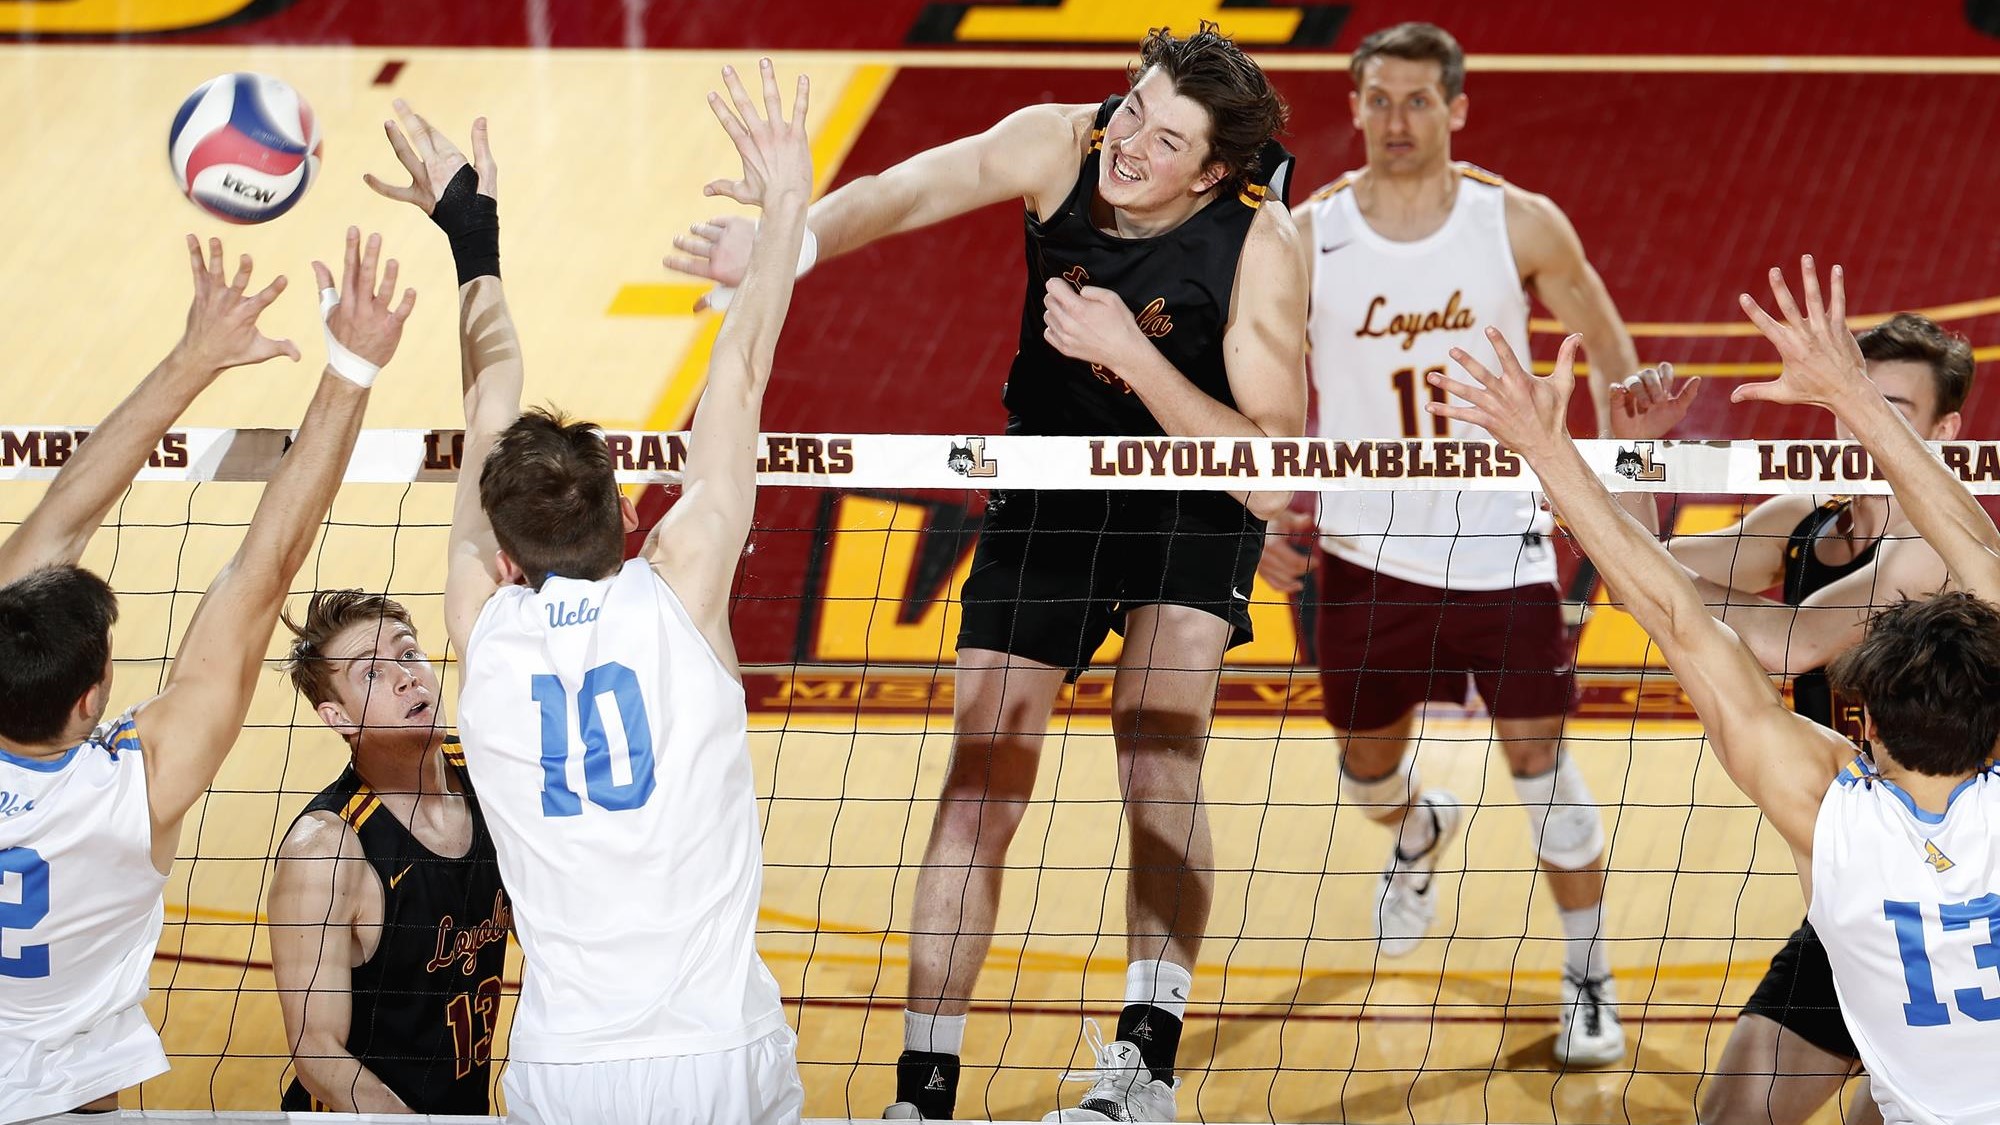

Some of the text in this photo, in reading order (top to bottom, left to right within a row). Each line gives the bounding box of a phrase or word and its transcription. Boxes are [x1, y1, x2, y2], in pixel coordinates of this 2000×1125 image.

[222, 172, 277, 204] NCAA
[1355, 289, 1476, 350] Loyola
[1391, 365, 1450, 438] 11
[1090, 440, 1521, 478] LOYOLA RAMBLERS
[1758, 445, 1887, 481] LOYO
[545, 598, 599, 628] Ucla
[531, 661, 657, 817] 10
[1884, 893, 2000, 1026] 13
